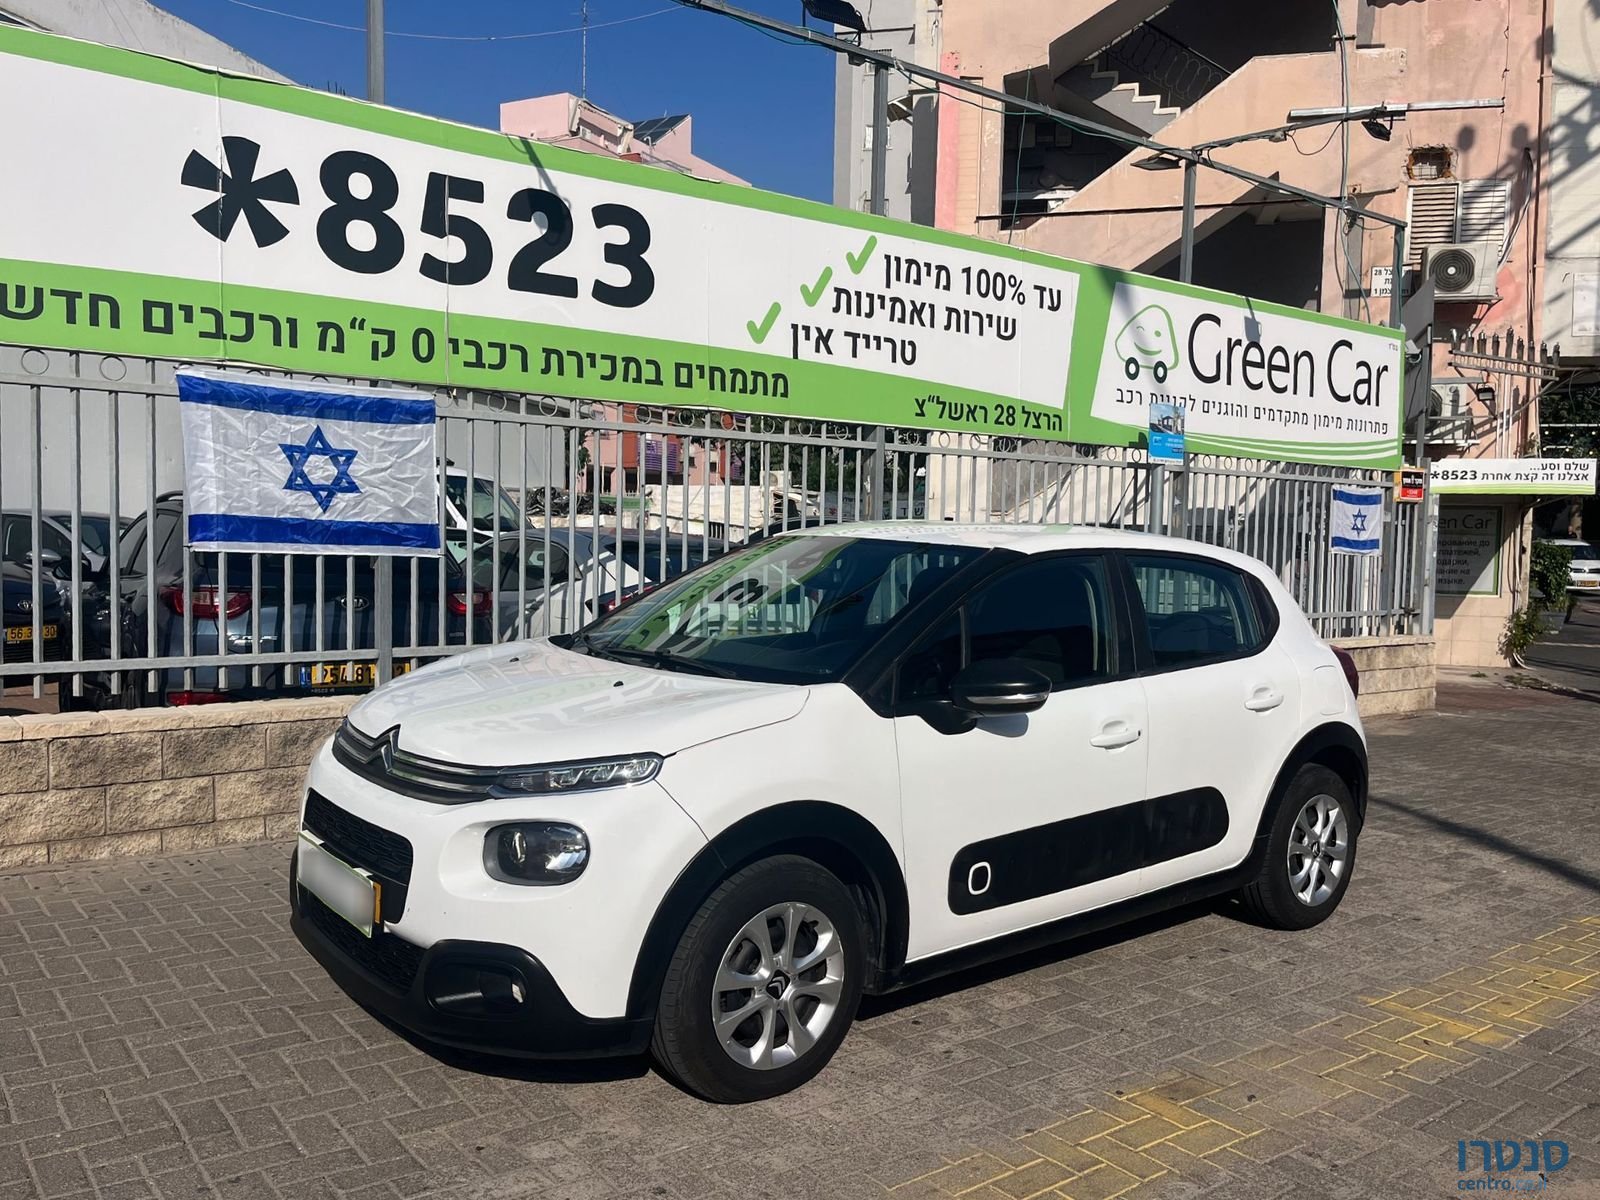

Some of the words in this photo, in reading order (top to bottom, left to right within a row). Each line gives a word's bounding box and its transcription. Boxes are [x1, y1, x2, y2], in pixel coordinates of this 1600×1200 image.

[884, 254, 951, 291] מימון
[961, 267, 1026, 305] 100%
[832, 287, 935, 329] ואמינות
[1033, 284, 1062, 312] עד
[143, 299, 299, 349] ורכבים
[943, 306, 1017, 341] שירות
[411, 327, 435, 364] 0
[791, 323, 834, 359] אין
[843, 331, 917, 366] טרייד
[447, 337, 529, 373] רכבי
[540, 347, 664, 386] במכירת
[1188, 313, 1315, 398] Green
[1327, 339, 1389, 407] Car
[675, 362, 789, 398] מתמחים
[1116, 388, 1143, 406] רכב
[1202, 399, 1248, 419] והוגנים
[994, 404, 1016, 427] 28
[1021, 405, 1063, 432] הרצל
[1254, 406, 1309, 427] מתקדמים
[1313, 413, 1342, 431] מימון
[1346, 417, 1389, 435] פתרונות
[1481, 471, 1511, 481] אחרת
[1514, 471, 1538, 482] קצת
[1541, 472, 1556, 481] זה
[1557, 471, 1589, 481] אצלנו
[1564, 462, 1590, 471] שלם
[1462, 514, 1492, 529] Car
